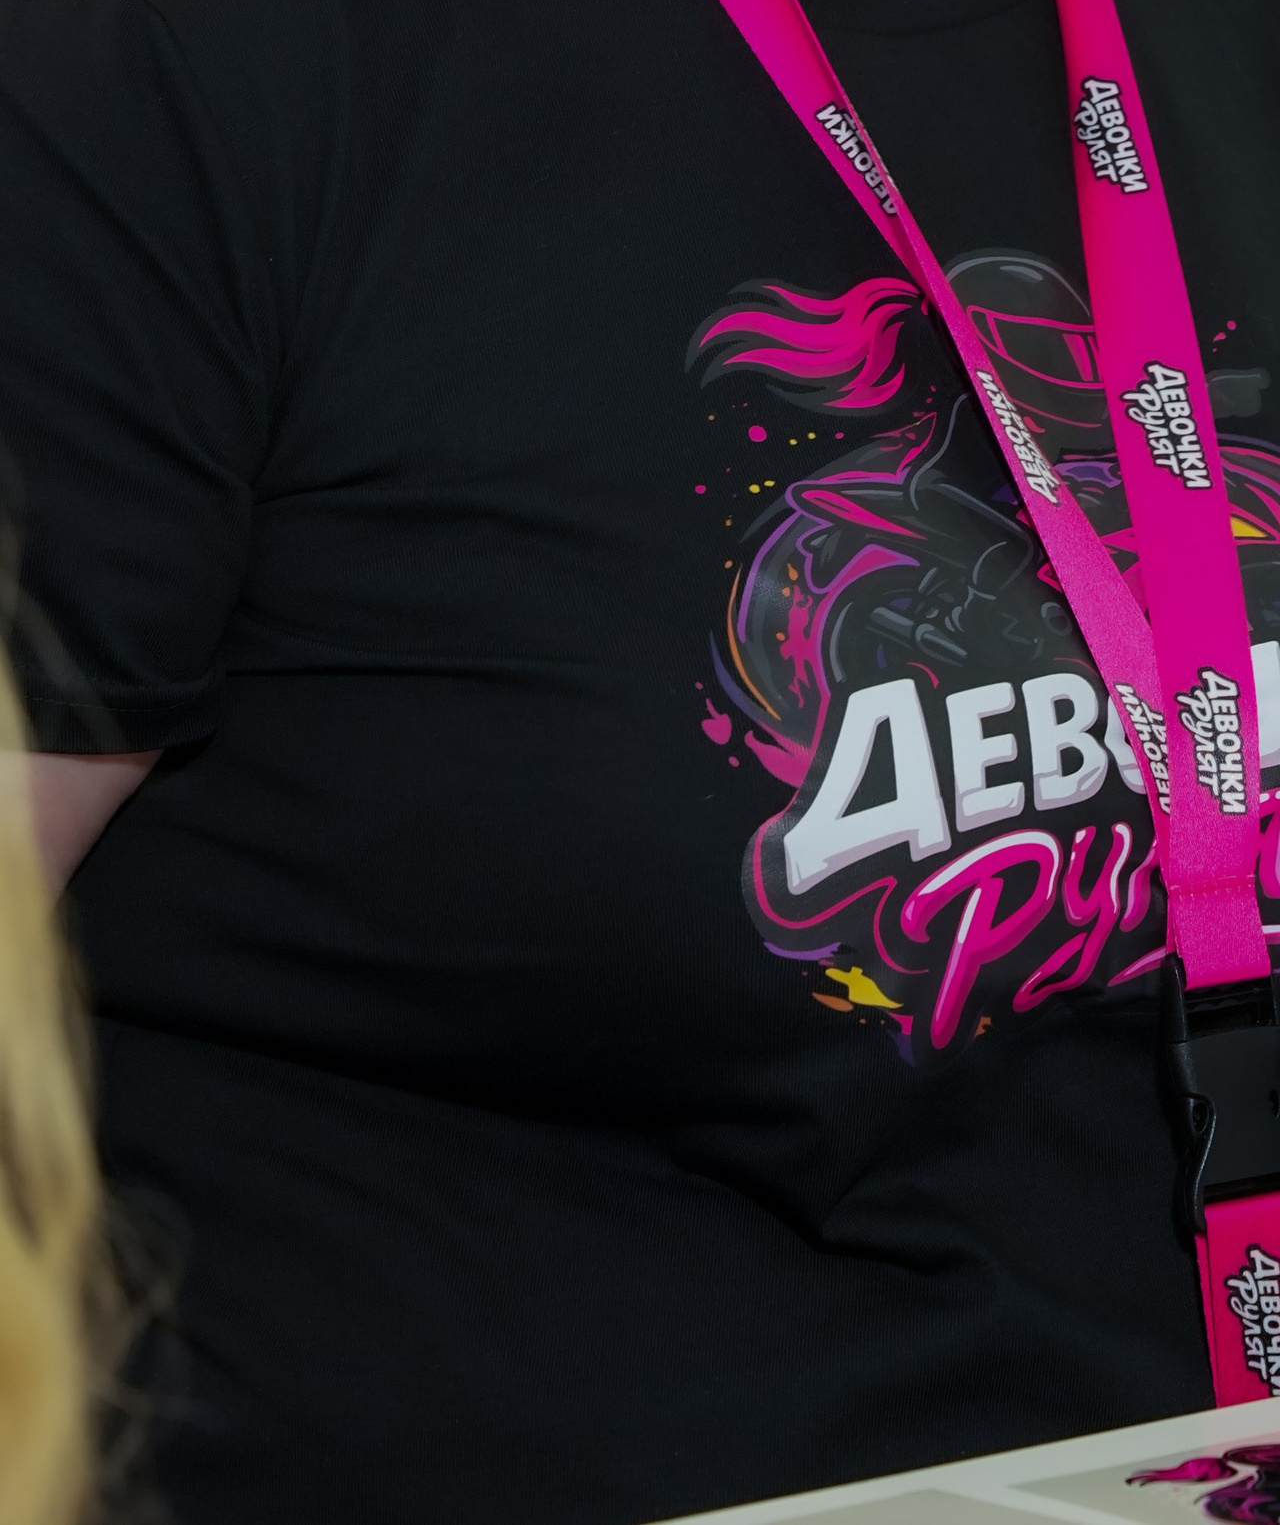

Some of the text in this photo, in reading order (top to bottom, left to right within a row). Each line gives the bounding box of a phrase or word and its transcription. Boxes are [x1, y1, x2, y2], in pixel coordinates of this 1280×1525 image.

[1083, 78, 1149, 194] ДЕВОЧКИ
[976, 370, 1060, 505] ДЕВОЧКИ
[1147, 362, 1213, 489] ДЕВОЧКИ
[1201, 670, 1247, 814] ДЕВОЧКИ
